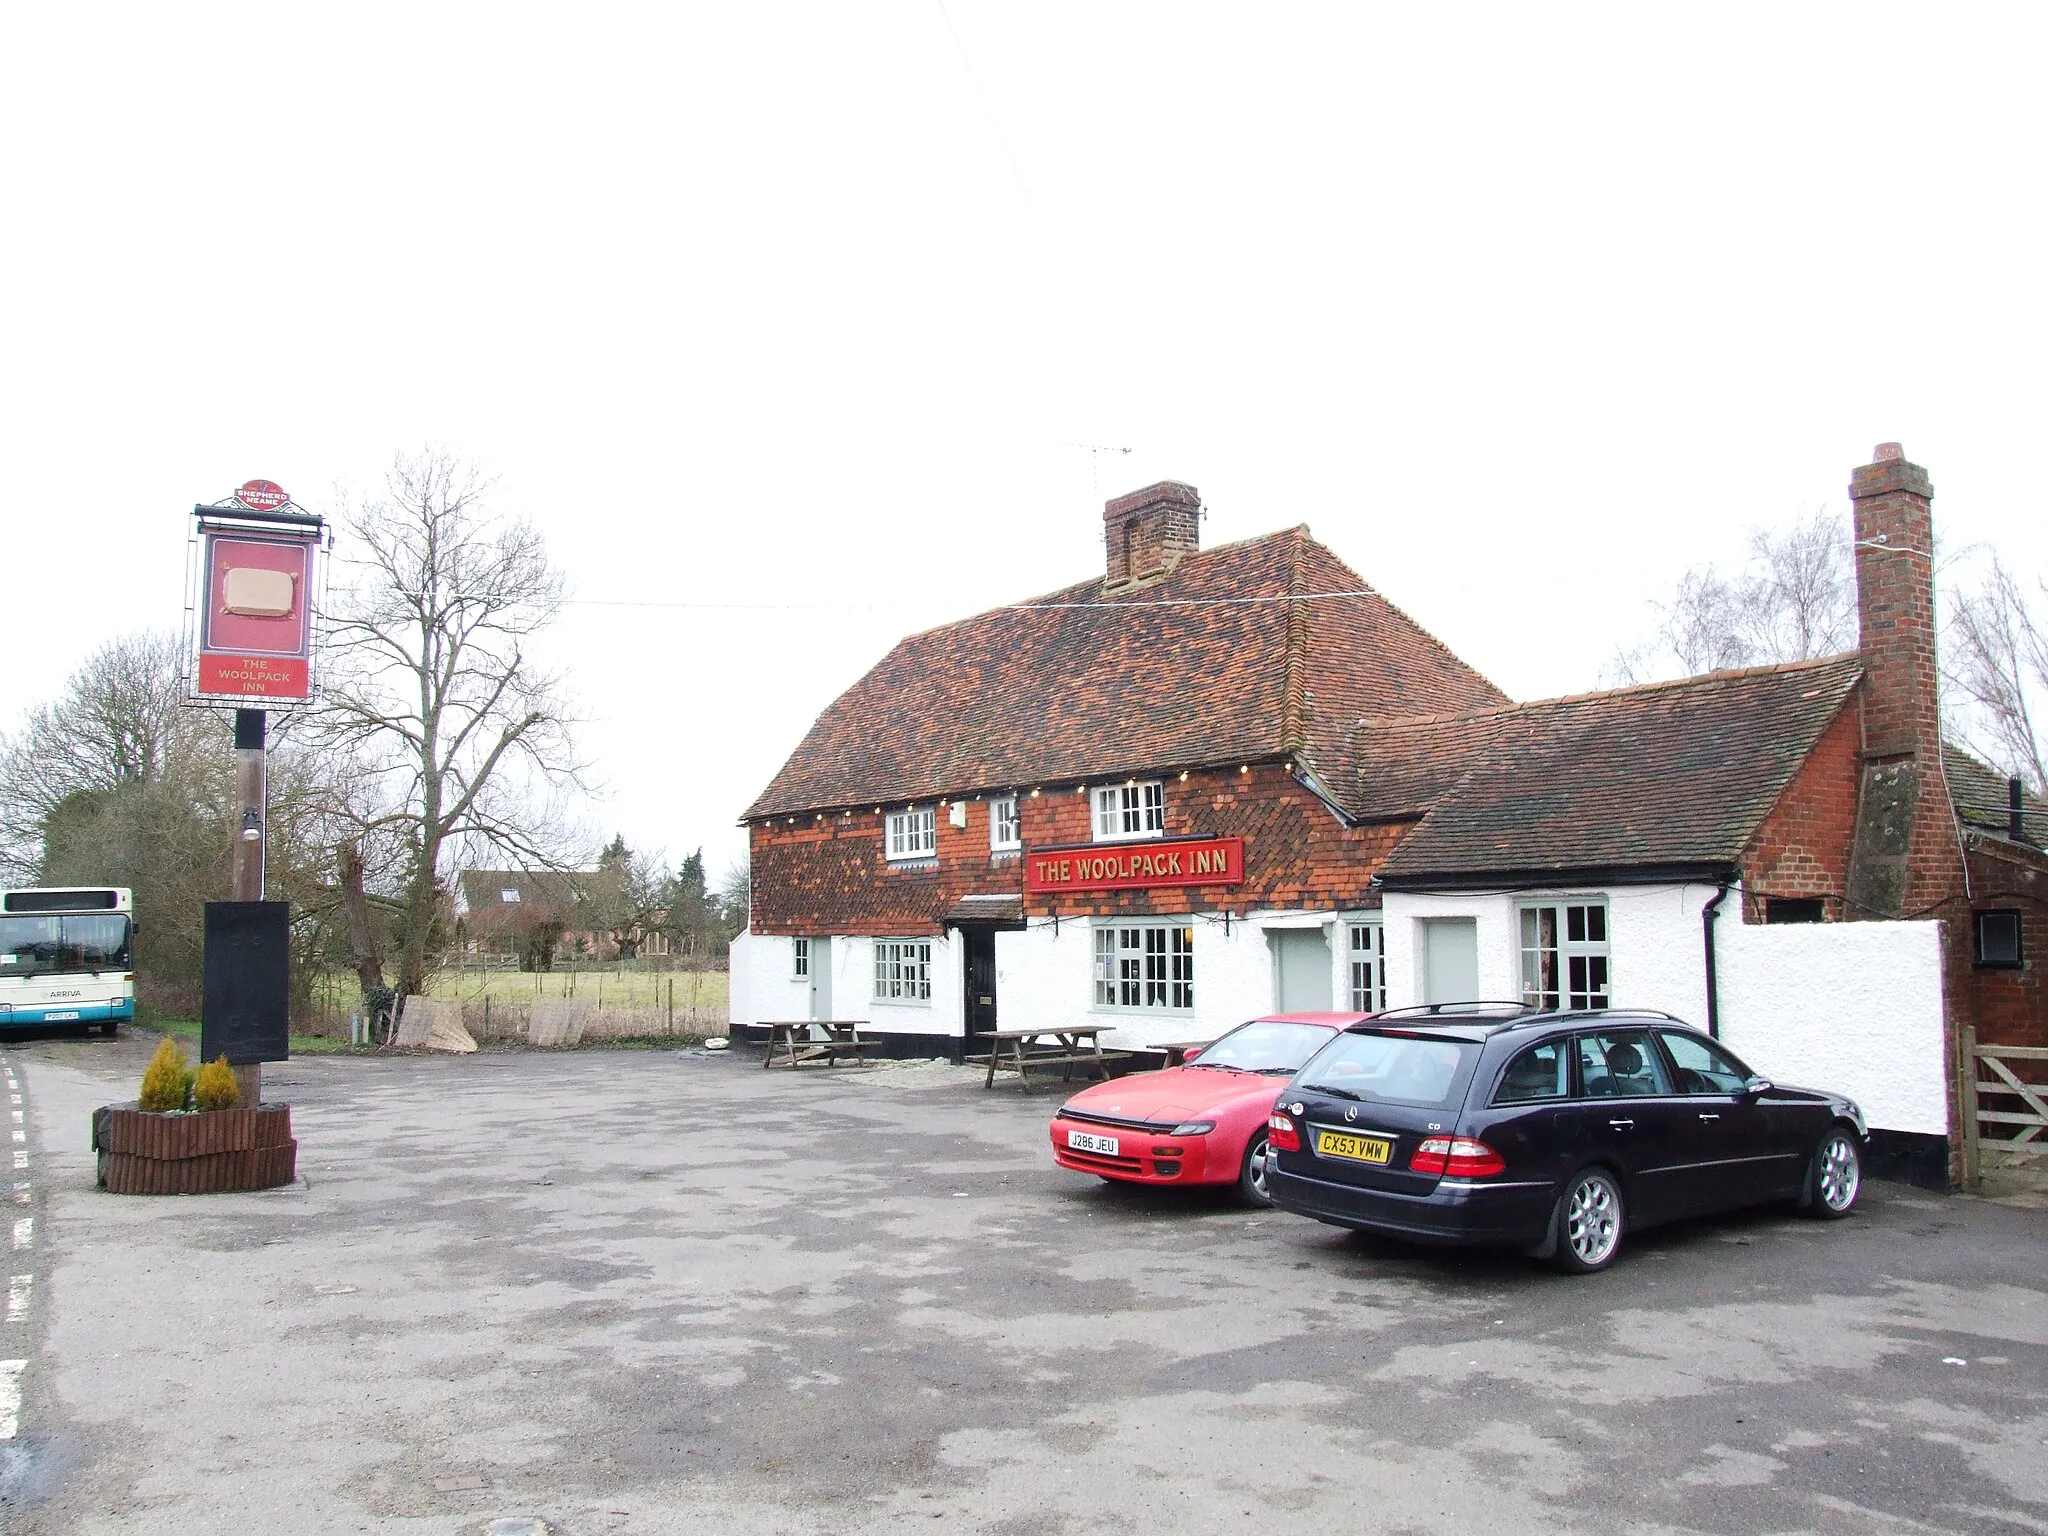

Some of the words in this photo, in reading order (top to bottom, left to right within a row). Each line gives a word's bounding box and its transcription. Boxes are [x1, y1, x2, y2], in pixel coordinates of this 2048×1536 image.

[238, 490, 287, 500] SHEPHERD
[246, 497, 278, 505] NEAME
[242, 659, 268, 669] THE
[219, 670, 290, 682] WOOLPACK
[243, 682, 265, 691] INN
[1036, 861, 1070, 882] THE
[1076, 853, 1181, 880] WOOLPACK
[1189, 849, 1226, 874] INN
[50, 990, 81, 998] ARRIVA
[1072, 1134, 1094, 1149] J286
[1096, 1139, 1114, 1152] JEU
[1324, 1136, 1355, 1154] CX53
[1359, 1141, 1384, 1159] VMW
